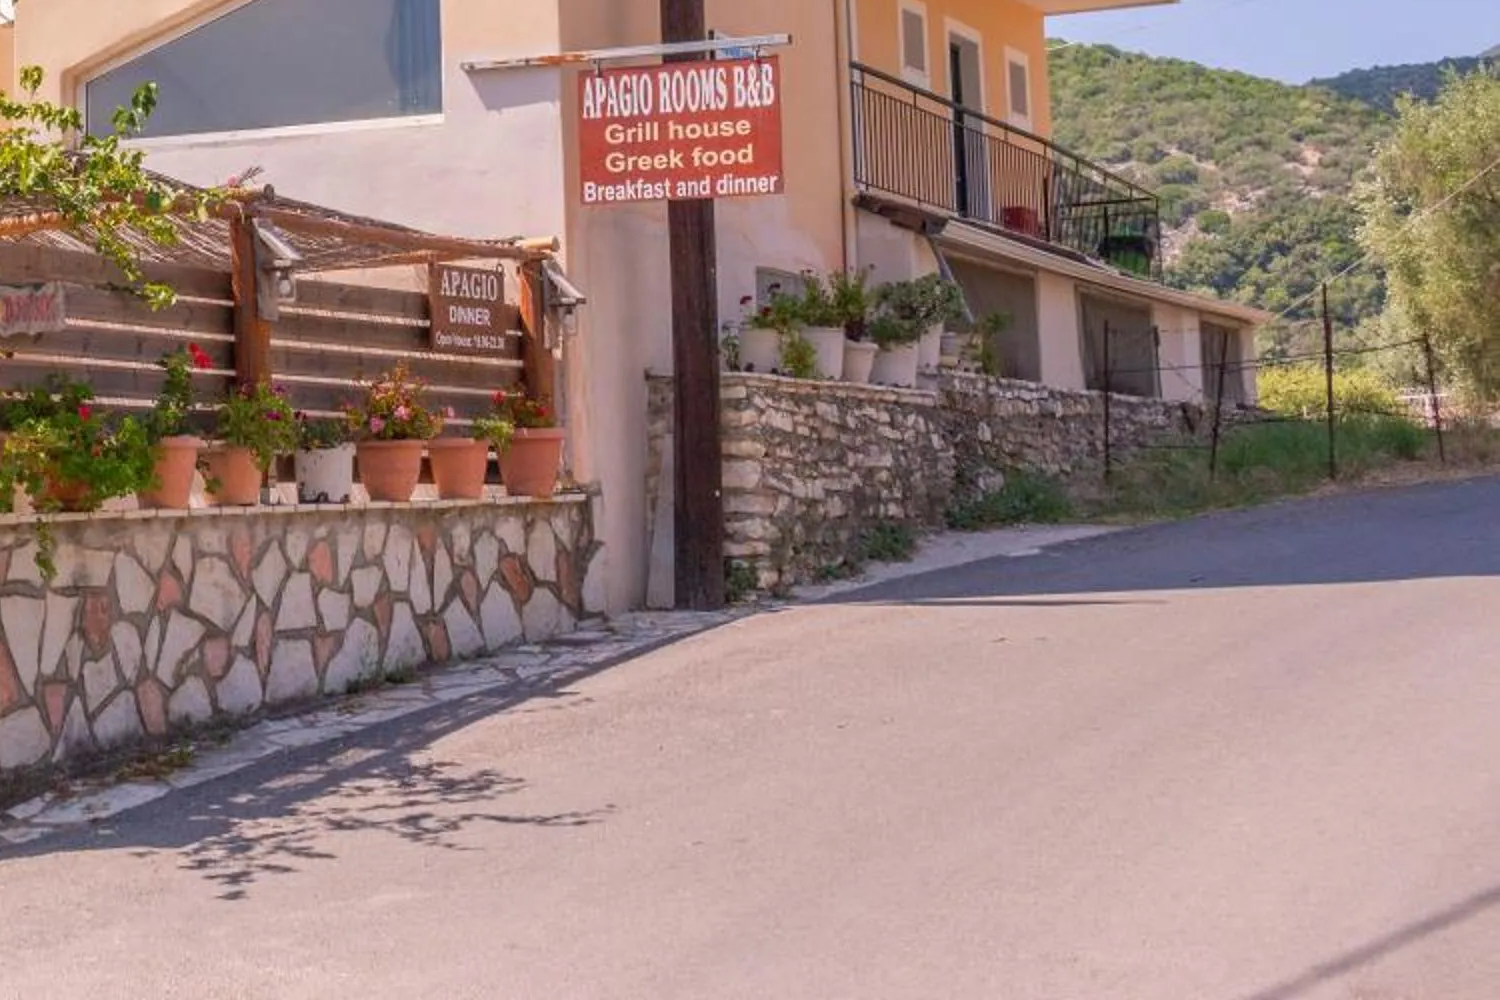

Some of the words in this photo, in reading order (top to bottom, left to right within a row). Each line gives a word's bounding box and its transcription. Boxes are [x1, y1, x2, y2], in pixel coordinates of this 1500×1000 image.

[582, 72, 653, 119] APAGIO
[658, 66, 728, 114] ROOMS
[733, 62, 775, 108] B&B
[604, 121, 659, 145] Grill
[668, 118, 751, 141] house
[605, 149, 684, 173] Greek
[692, 144, 754, 167] food
[583, 177, 671, 203] Breakfast
[676, 174, 711, 198] and
[716, 172, 778, 195] dinner
[440, 269, 498, 301] APAGIO
[449, 304, 491, 326] DINNER
